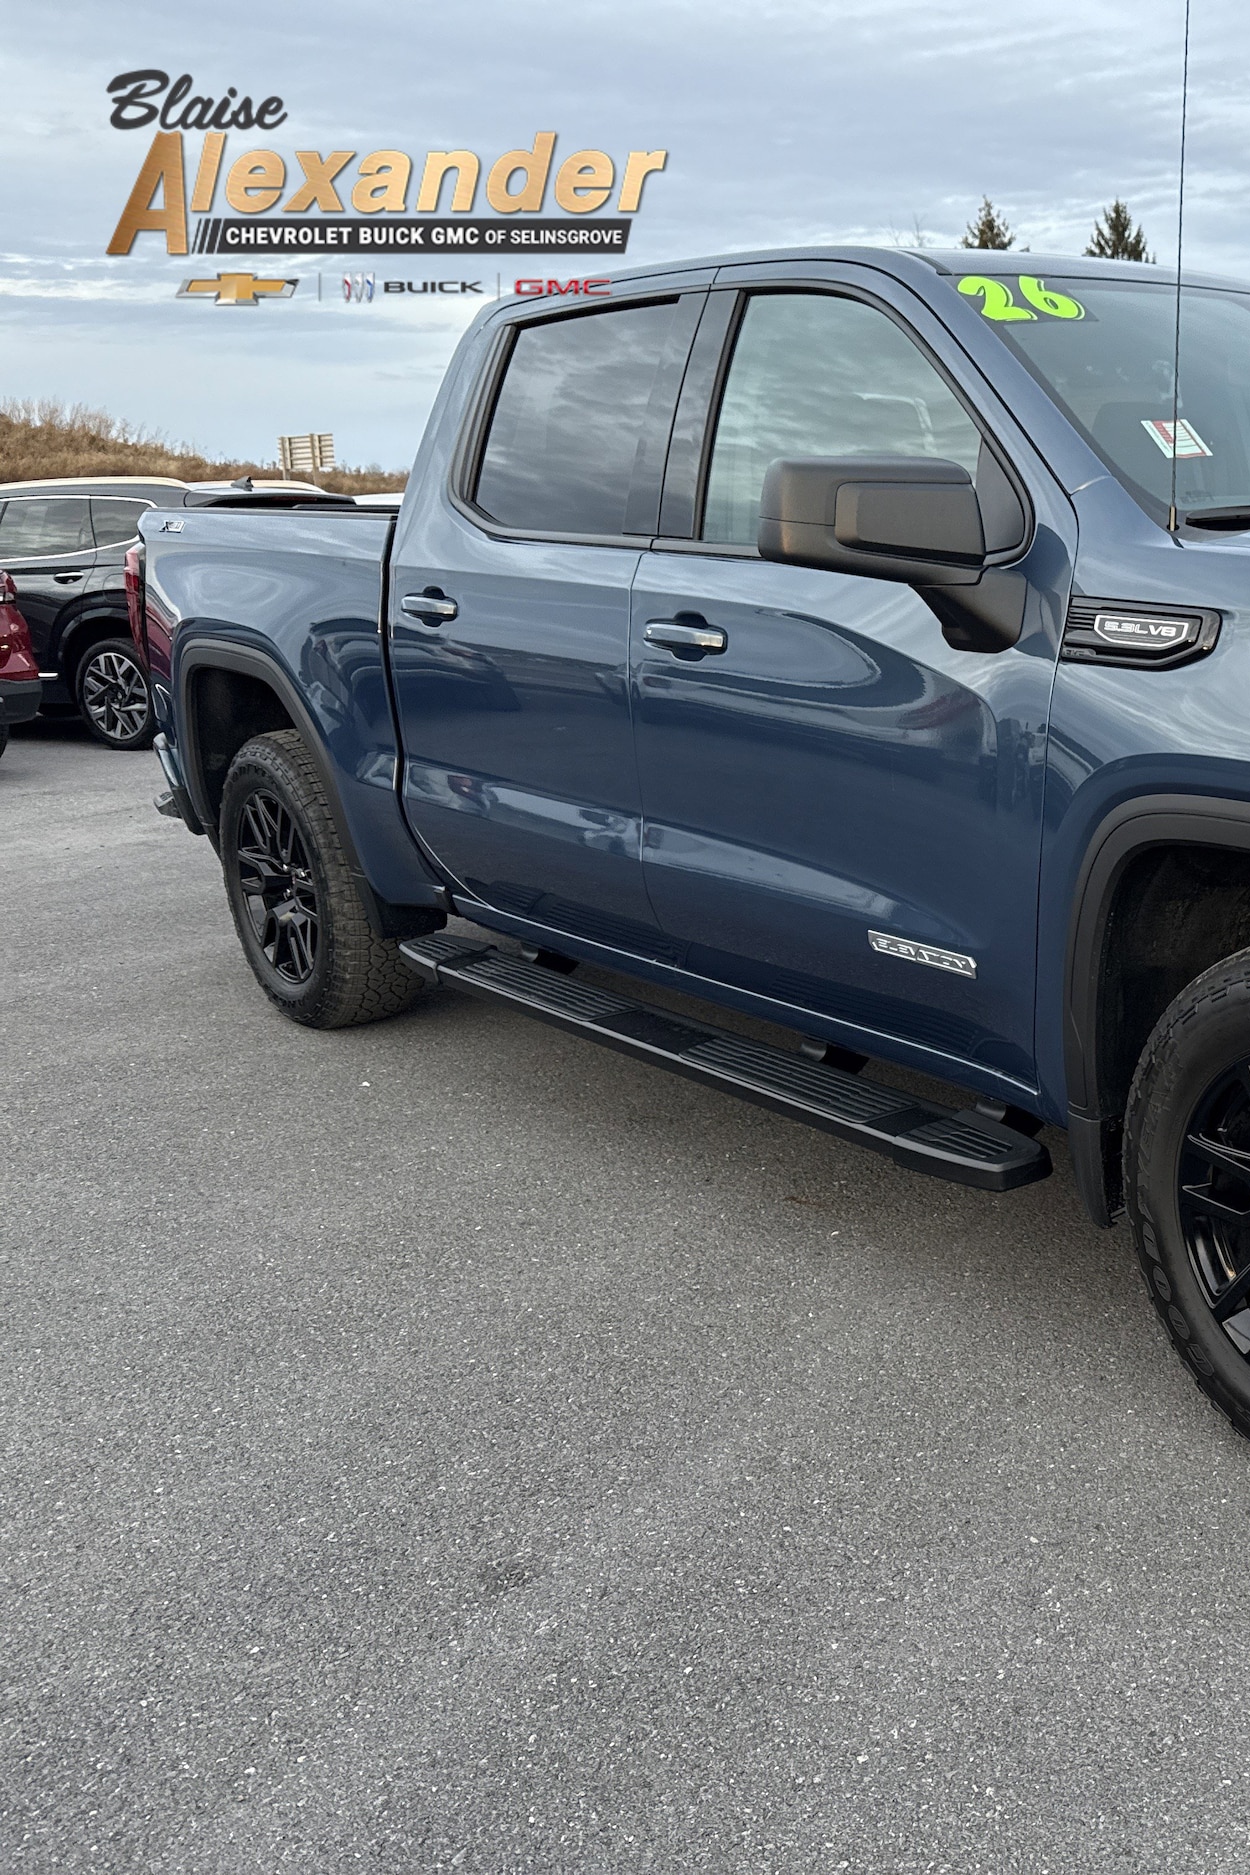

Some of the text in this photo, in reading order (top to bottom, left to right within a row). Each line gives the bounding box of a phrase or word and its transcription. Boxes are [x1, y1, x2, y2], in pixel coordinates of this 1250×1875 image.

[957, 275, 1085, 321] 26
[1148, 624, 1177, 637] V8
[873, 937, 967, 970] ELEVATON
